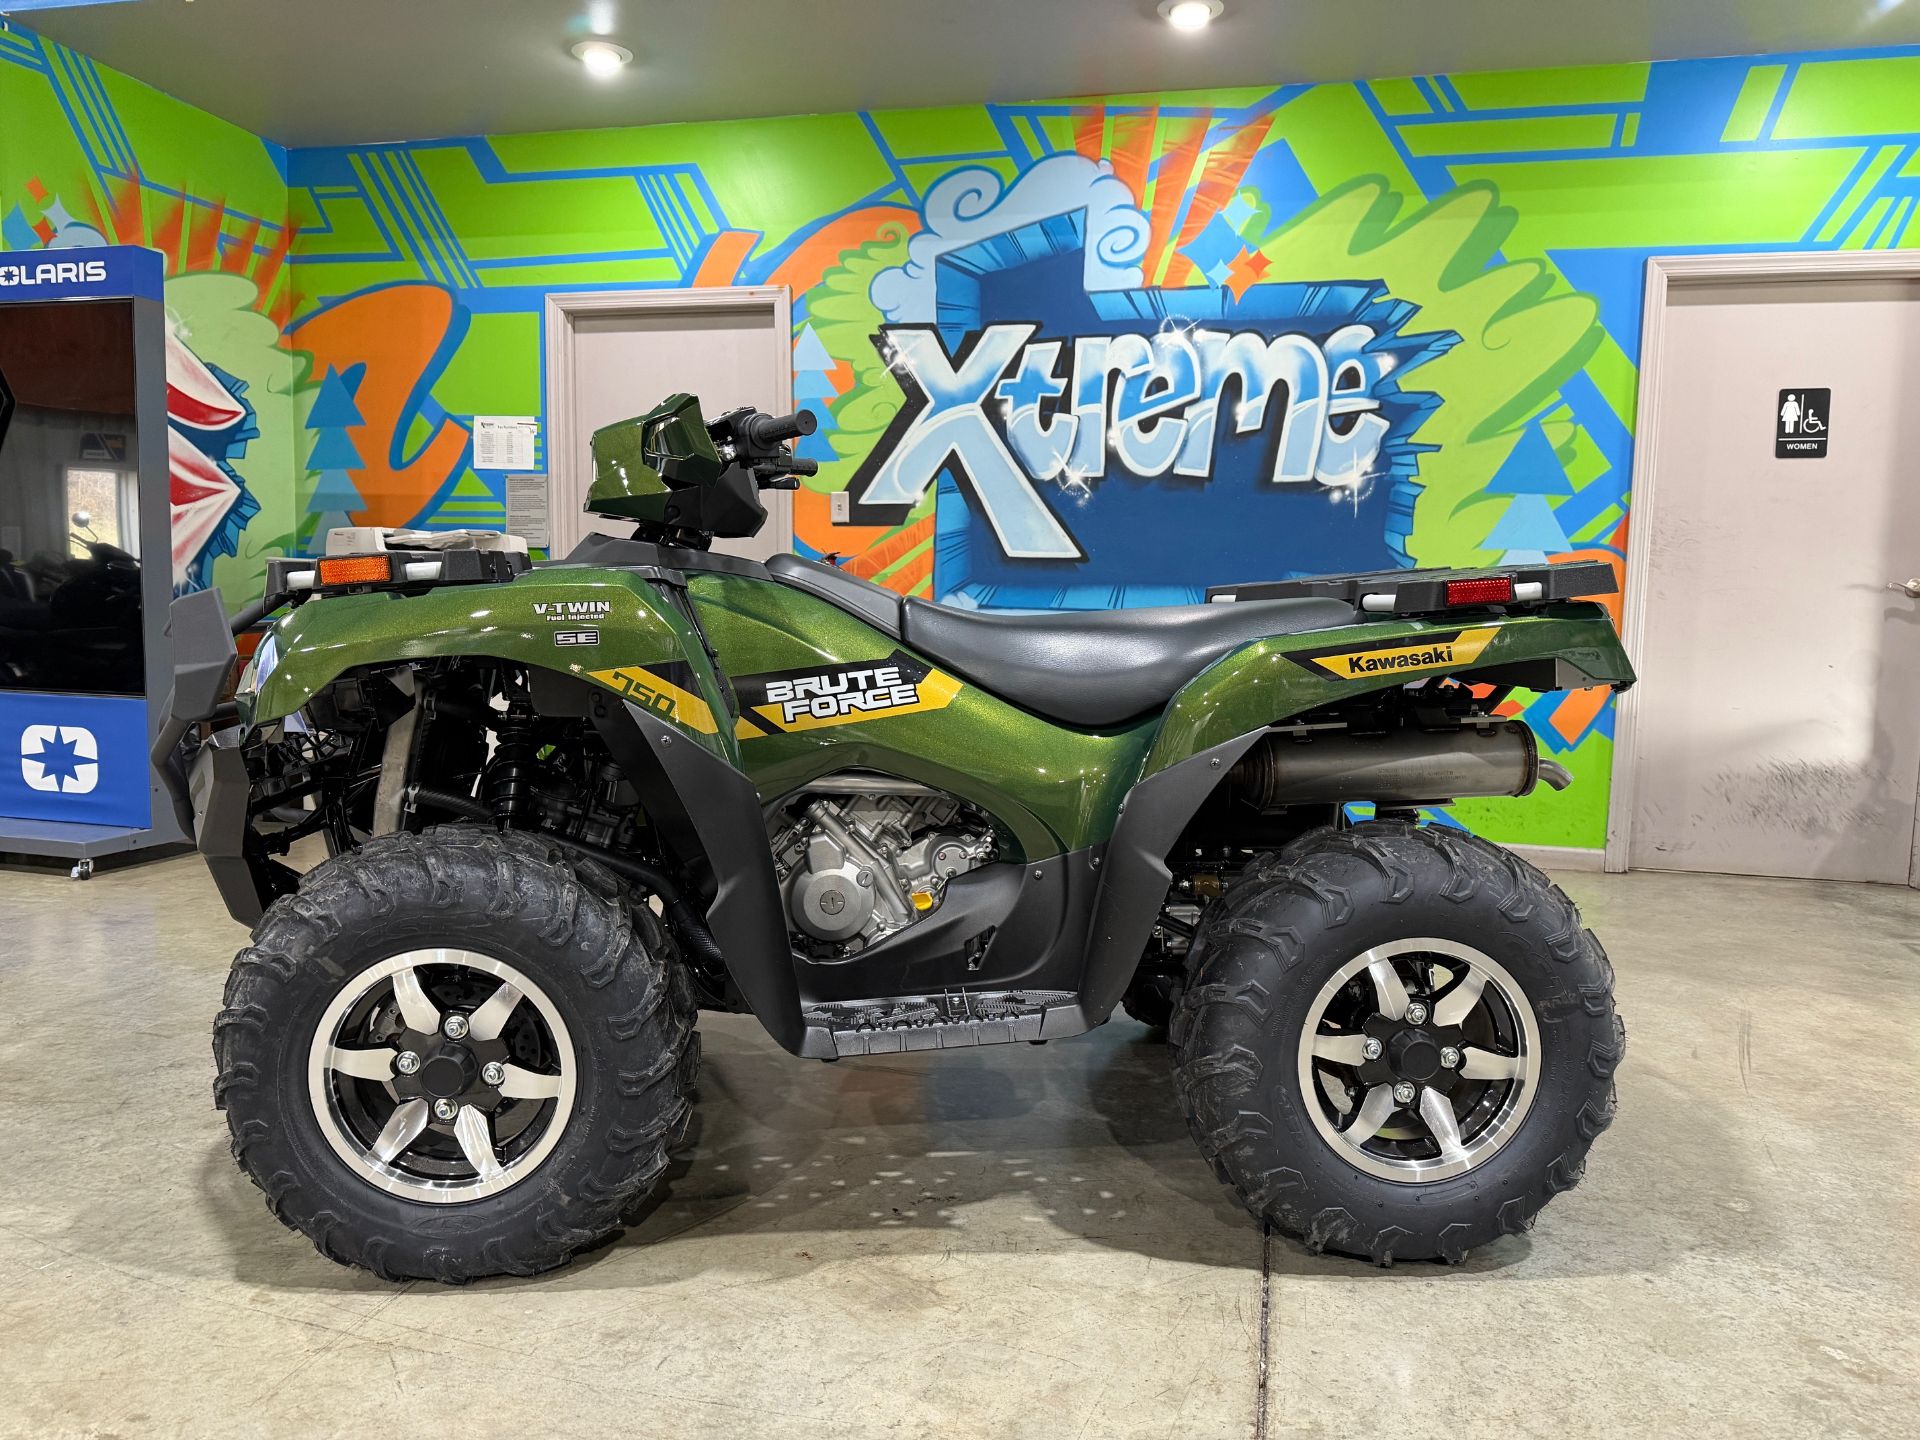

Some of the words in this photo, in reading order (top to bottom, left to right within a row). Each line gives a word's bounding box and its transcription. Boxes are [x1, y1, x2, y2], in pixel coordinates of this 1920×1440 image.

[0, 261, 107, 286] OLARIS
[856, 322, 1393, 561] Xtreme
[533, 601, 611, 615] V-TWIN
[546, 614, 565, 622] Fuel
[567, 613, 605, 622] Injected
[555, 631, 598, 645] SE
[1348, 645, 1453, 674] Kawasaki
[611, 670, 678, 717] 750
[765, 666, 903, 703] BRUTE
[783, 683, 920, 723] FORCE
